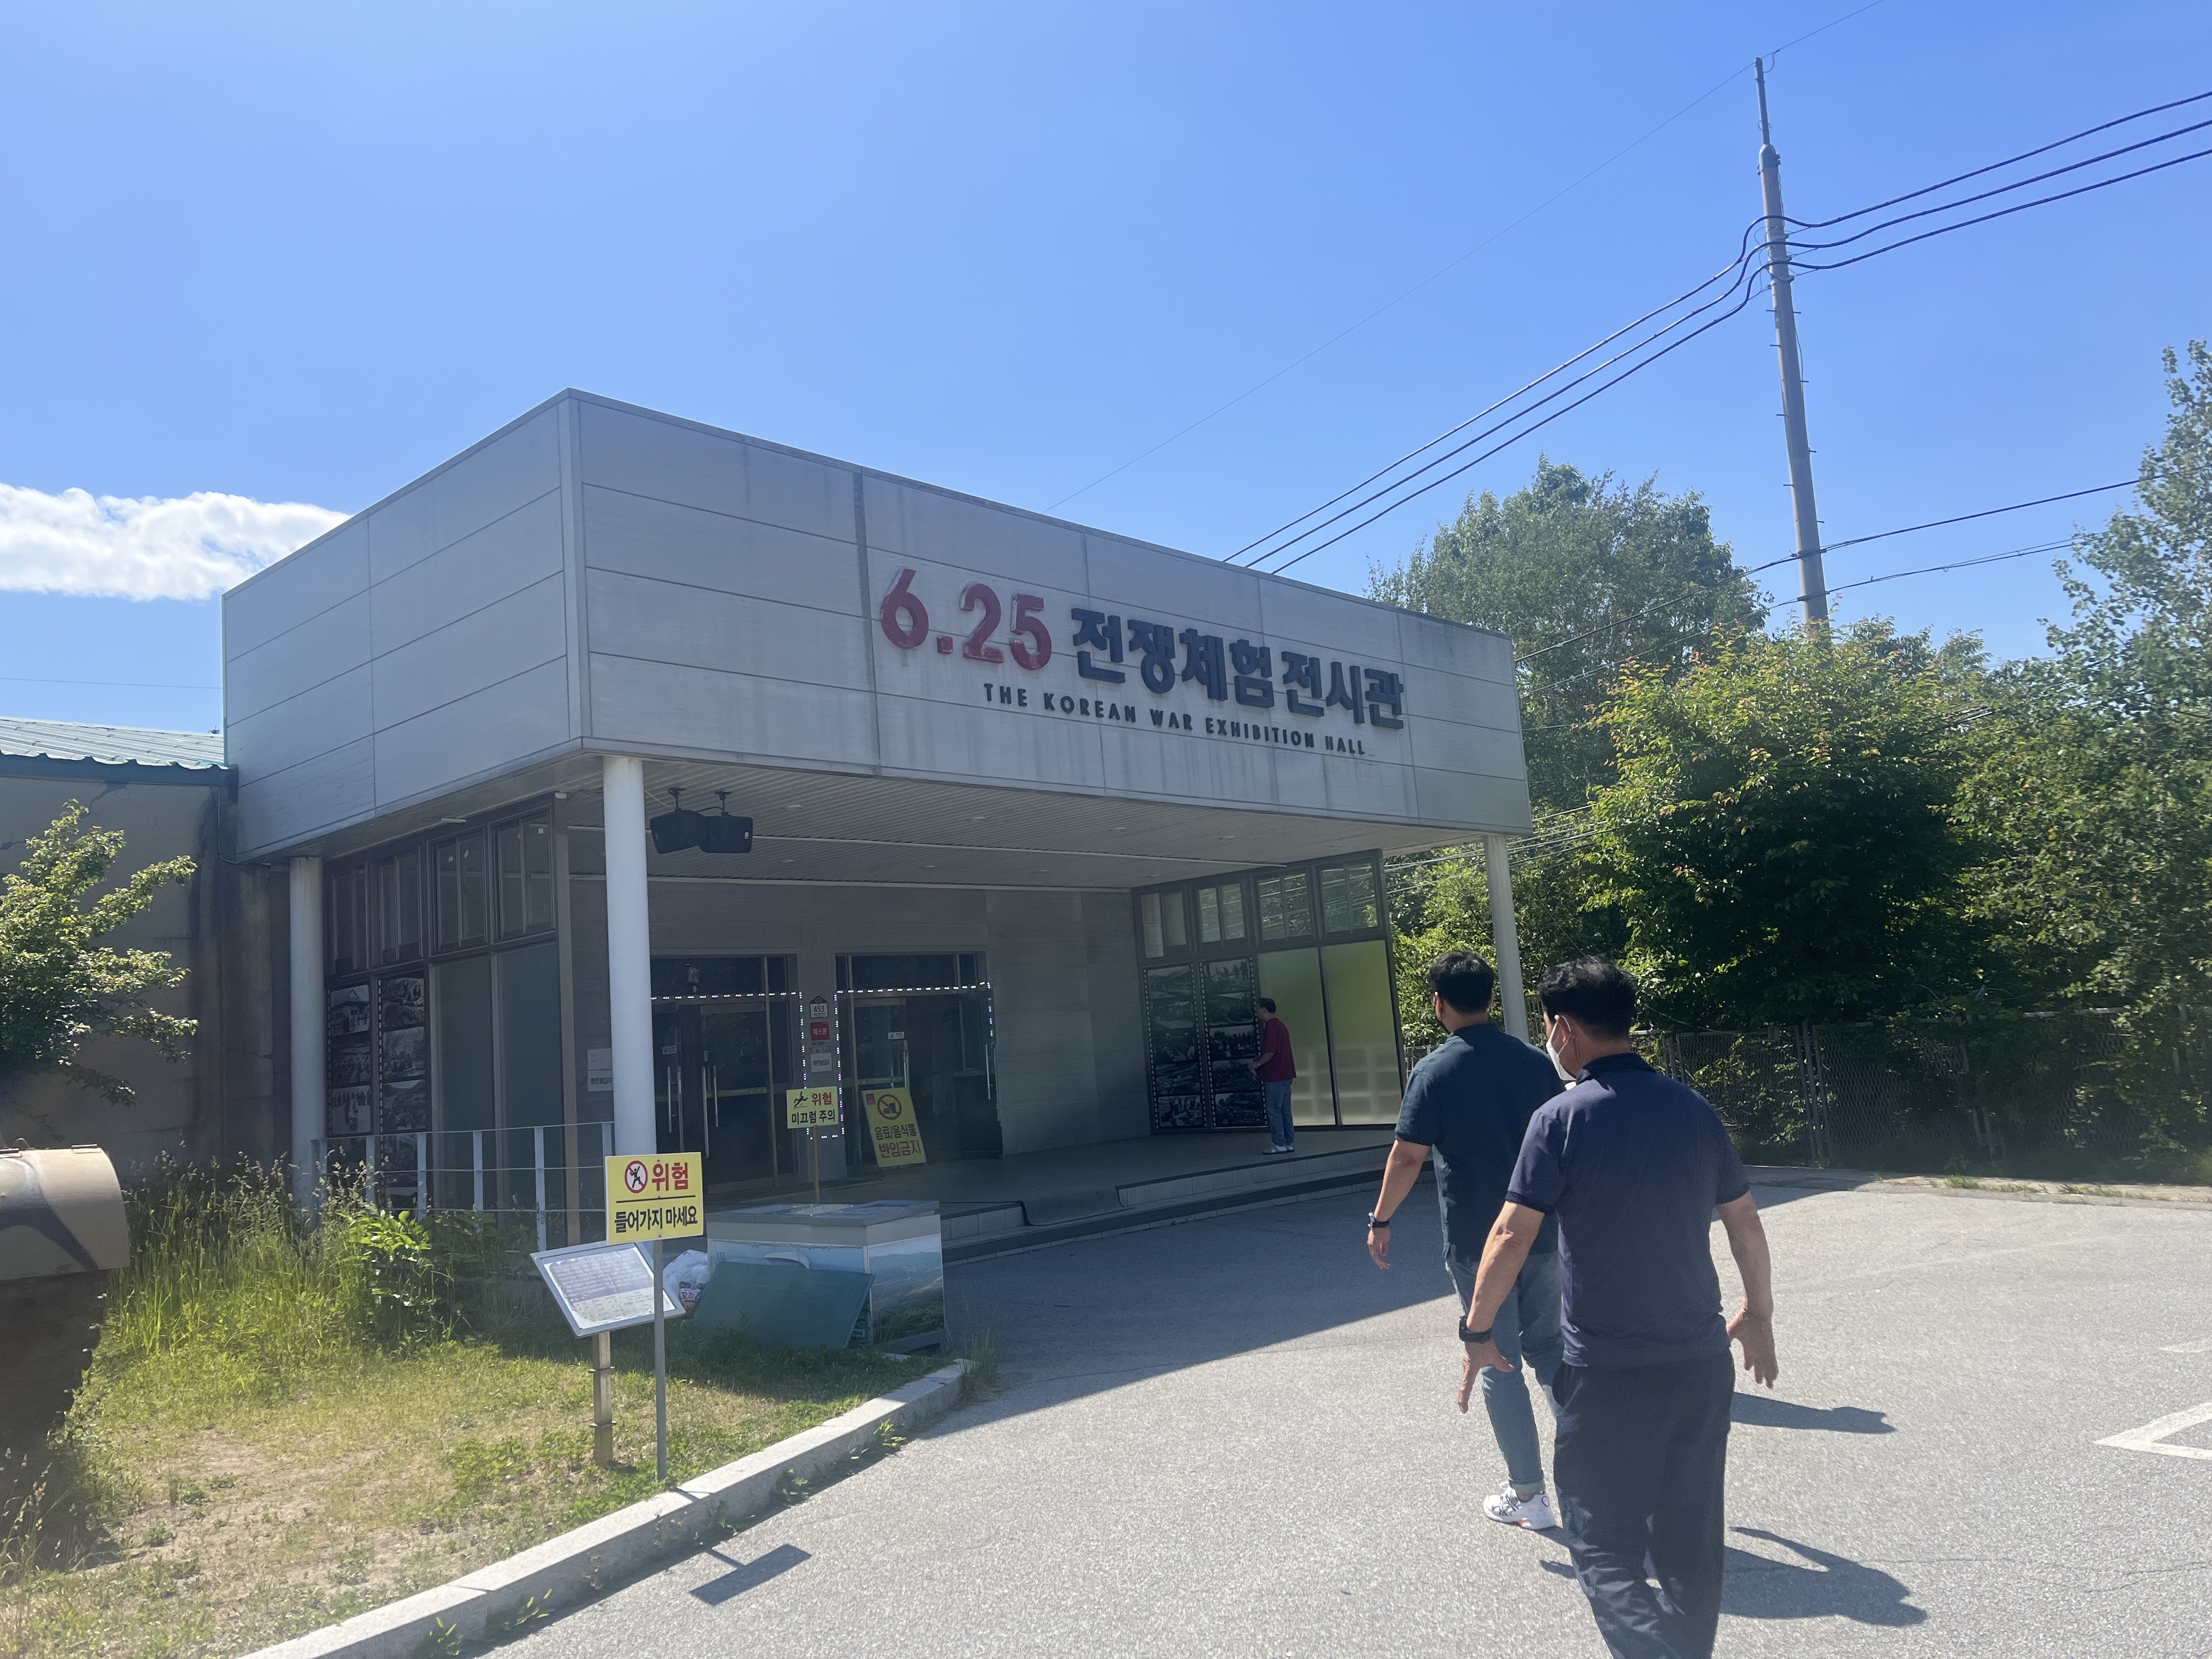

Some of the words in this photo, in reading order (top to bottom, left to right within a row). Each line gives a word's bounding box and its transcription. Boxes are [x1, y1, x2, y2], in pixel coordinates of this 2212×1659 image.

[881, 568, 1052, 670] 6.25
[984, 683, 1028, 707] THE
[1044, 692, 1136, 723] KOREAN
[1150, 709, 1193, 731] WAR
[1206, 717, 1314, 748] EXHIBITION
[1325, 735, 1365, 754] HALL
[811, 1092, 832, 1106] 위험
[792, 1110, 817, 1125] 미끄럼
[819, 1108, 836, 1122] 주의
[875, 1123, 917, 1140] 음료/음식물
[878, 1139, 922, 1159] 반입금지
[651, 1162, 689, 1191] 위험
[614, 1207, 663, 1233] 들어가지
[666, 1205, 698, 1228] 마세요
